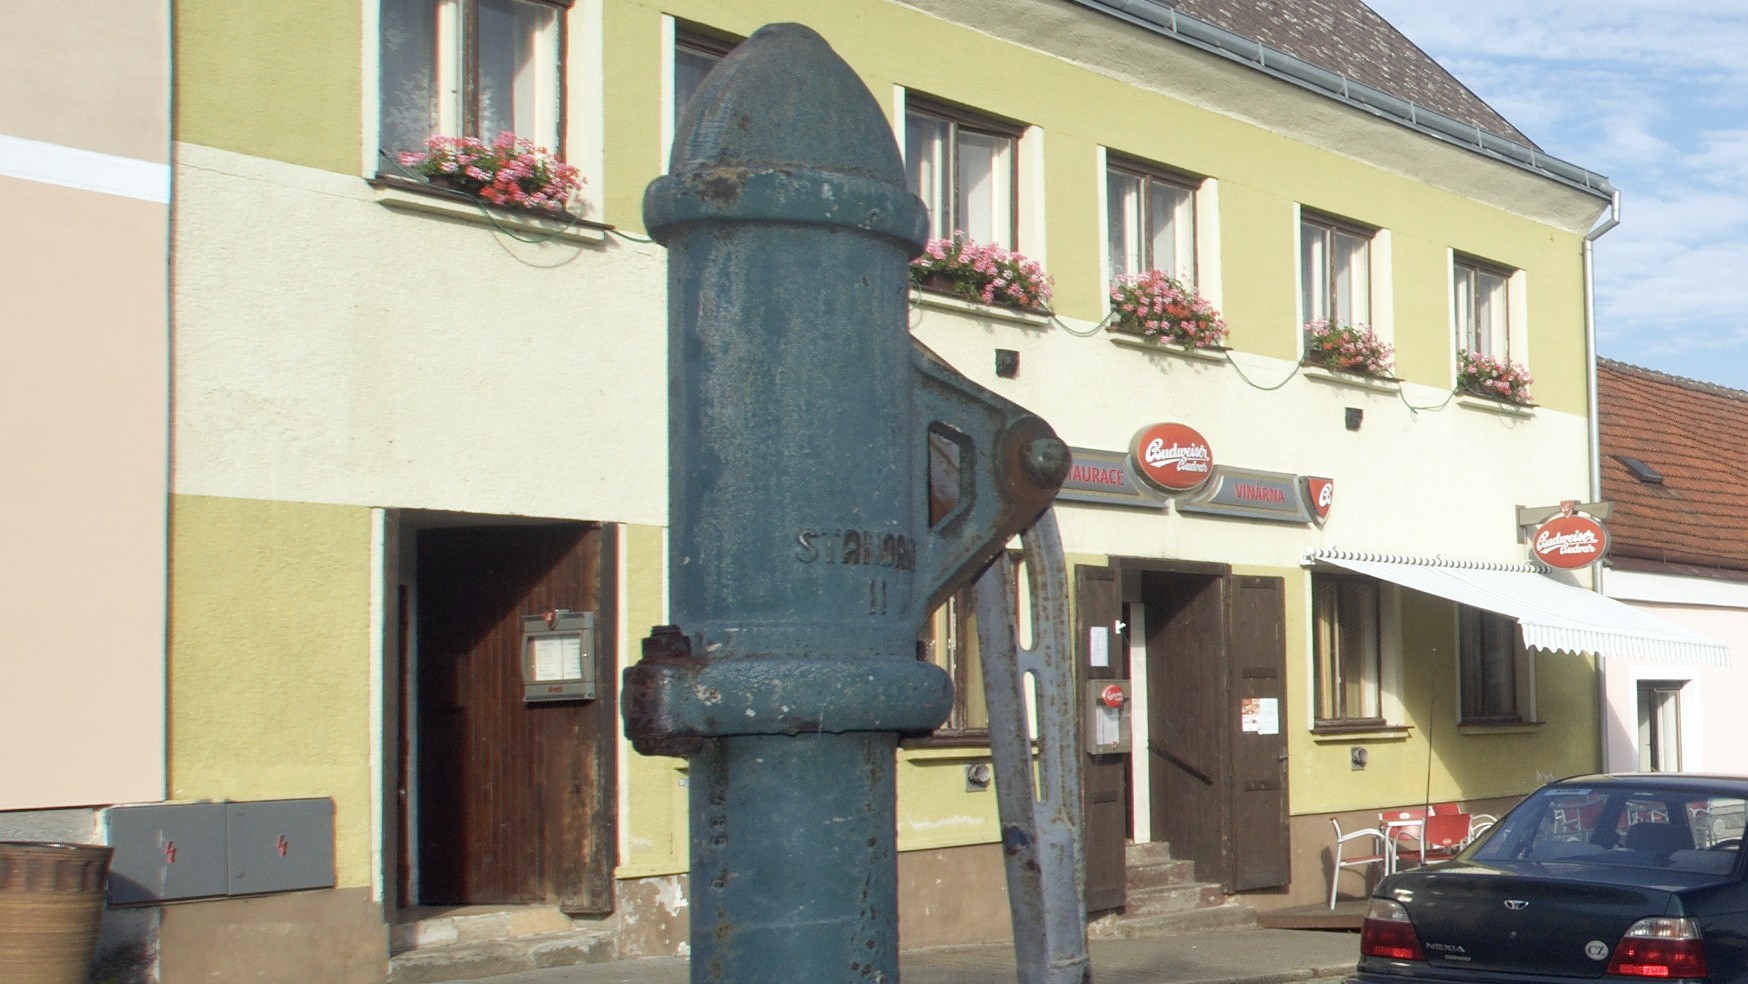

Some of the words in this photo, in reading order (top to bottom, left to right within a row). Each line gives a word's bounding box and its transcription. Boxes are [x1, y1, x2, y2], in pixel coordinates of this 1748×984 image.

[1145, 437, 1209, 463] Budweiser
[1536, 530, 1598, 551] Budweiser
[1425, 942, 1466, 954] NEXIA
[1587, 945, 1606, 957] CZ
